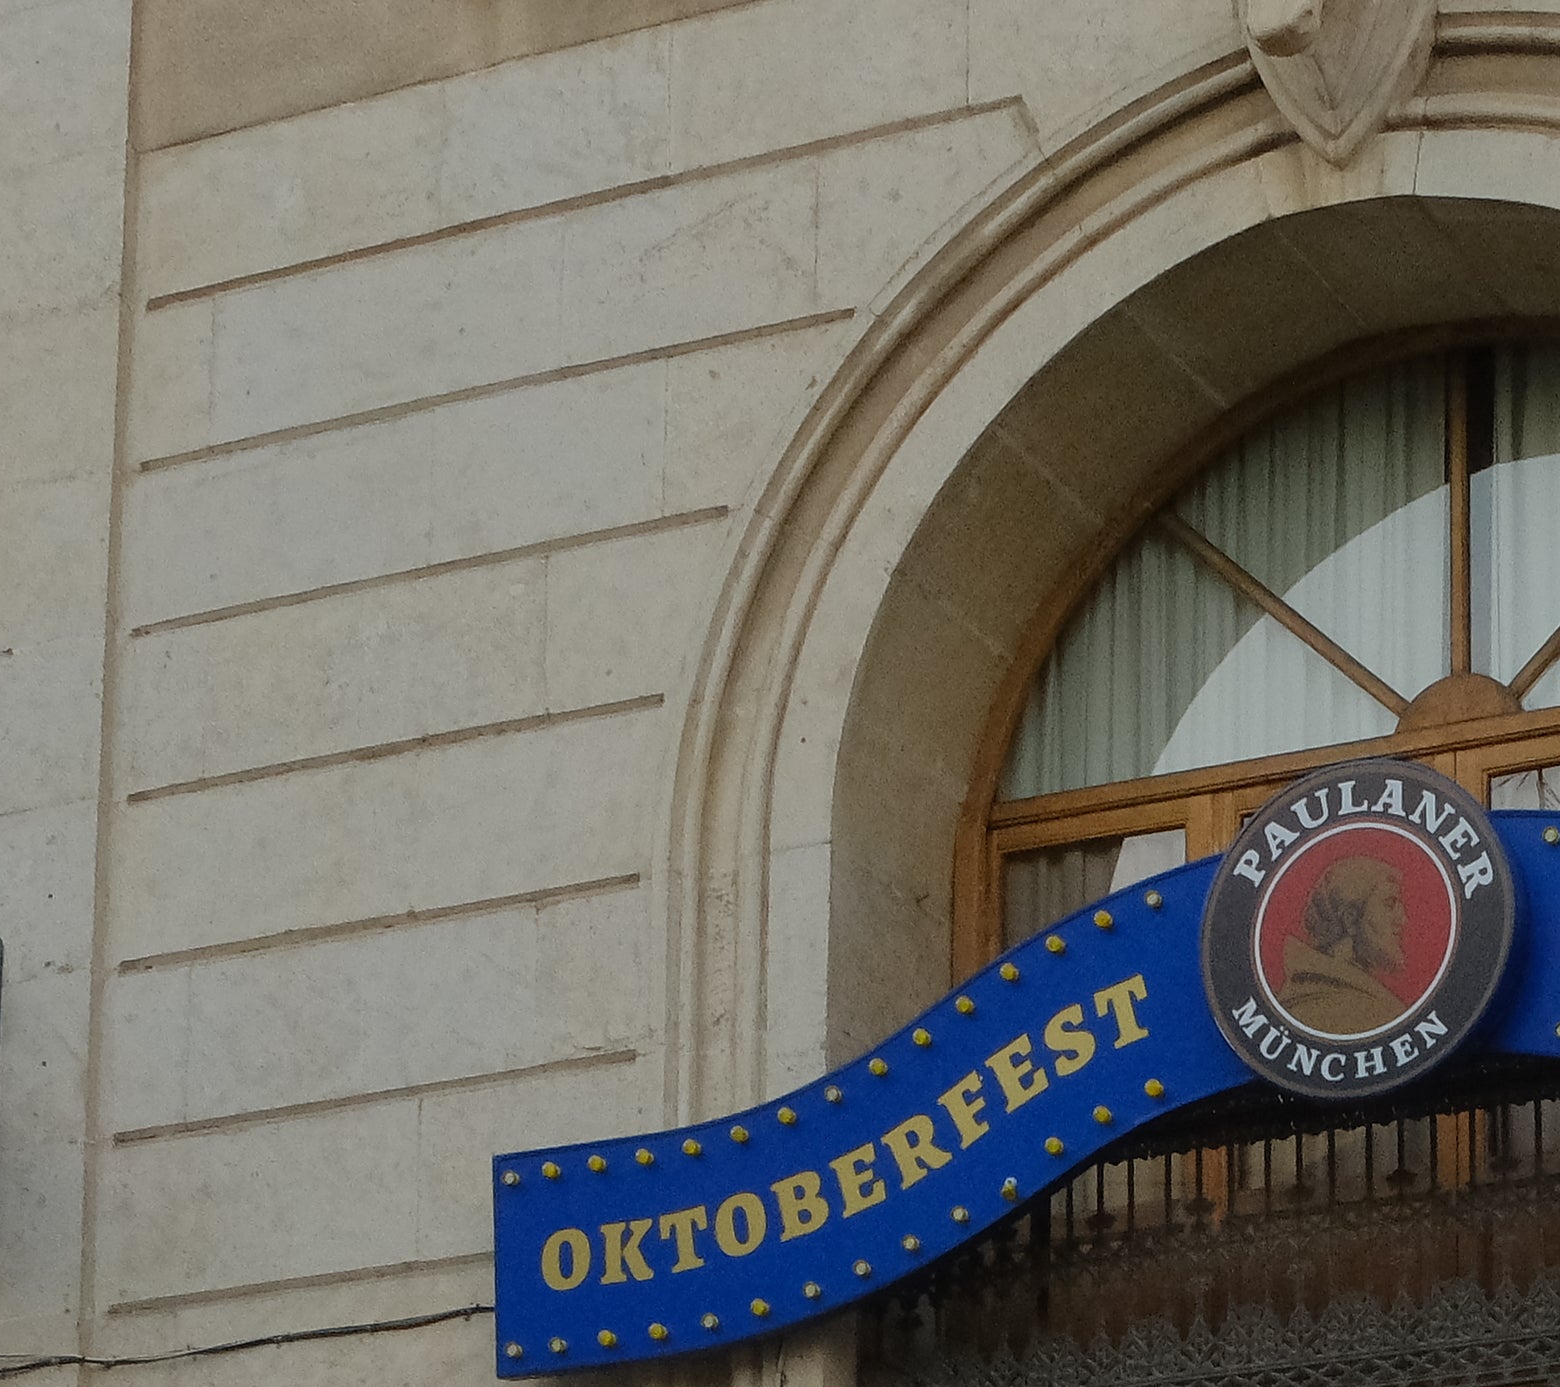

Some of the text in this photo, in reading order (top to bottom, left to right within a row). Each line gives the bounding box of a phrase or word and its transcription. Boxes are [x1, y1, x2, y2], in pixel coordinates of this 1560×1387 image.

[1231, 777, 1501, 904] PAULANER
[1229, 992, 1454, 1084] MÜNCHEN
[538, 970, 1153, 1295] OKTOBERFEST
